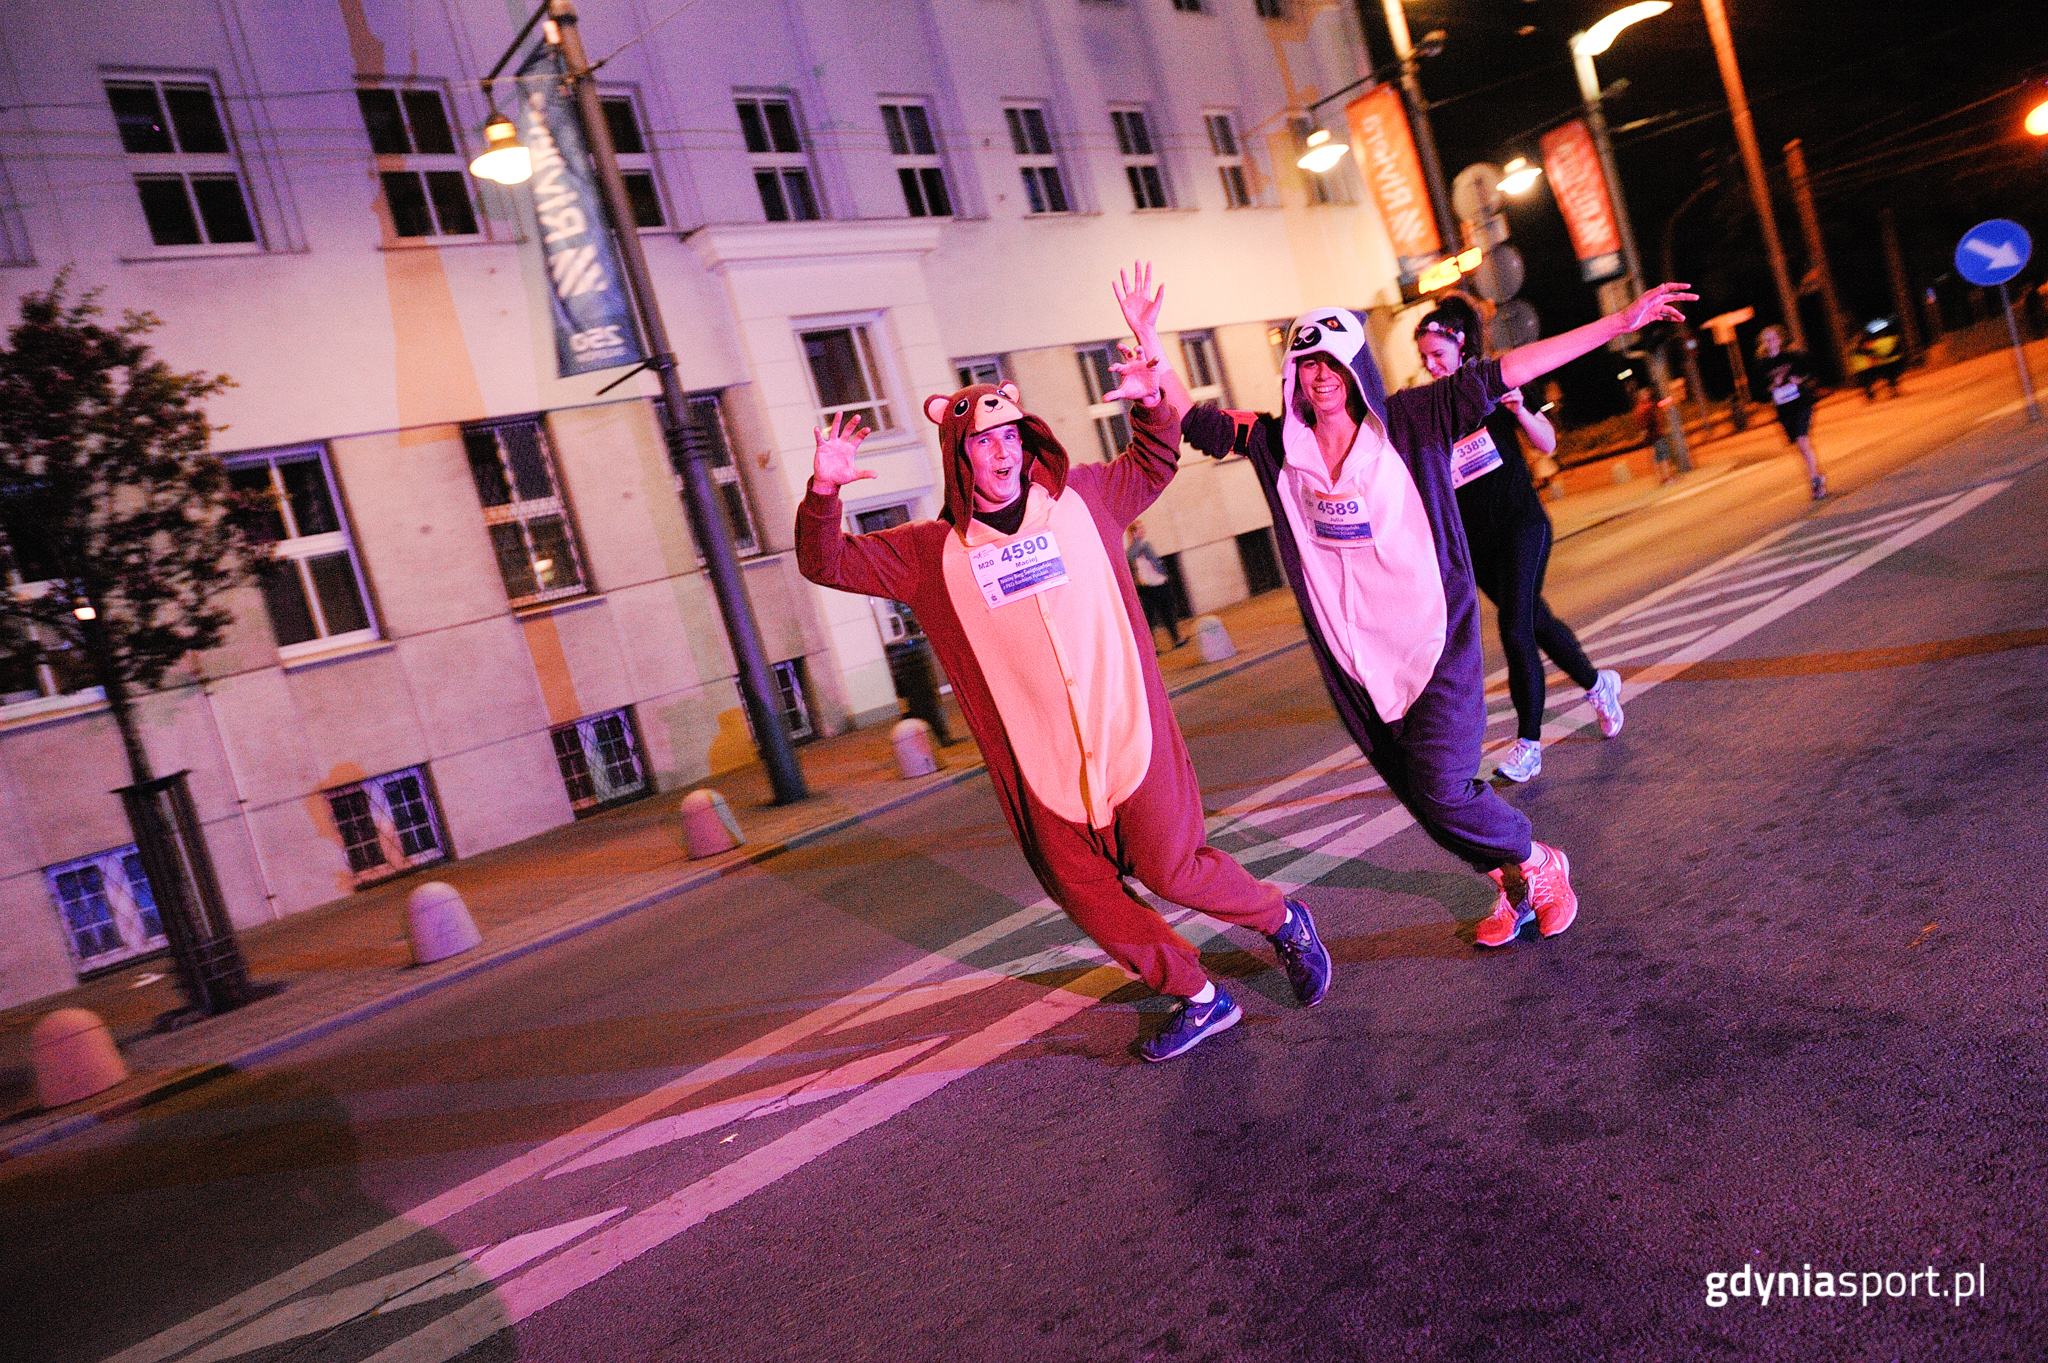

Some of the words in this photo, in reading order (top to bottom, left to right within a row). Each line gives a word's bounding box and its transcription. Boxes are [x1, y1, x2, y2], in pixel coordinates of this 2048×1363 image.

[1456, 436, 1487, 458] 3389
[1317, 500, 1359, 516] 4589
[1000, 535, 1049, 563] 4590
[977, 559, 995, 571] M20
[1015, 556, 1039, 568] Maciej
